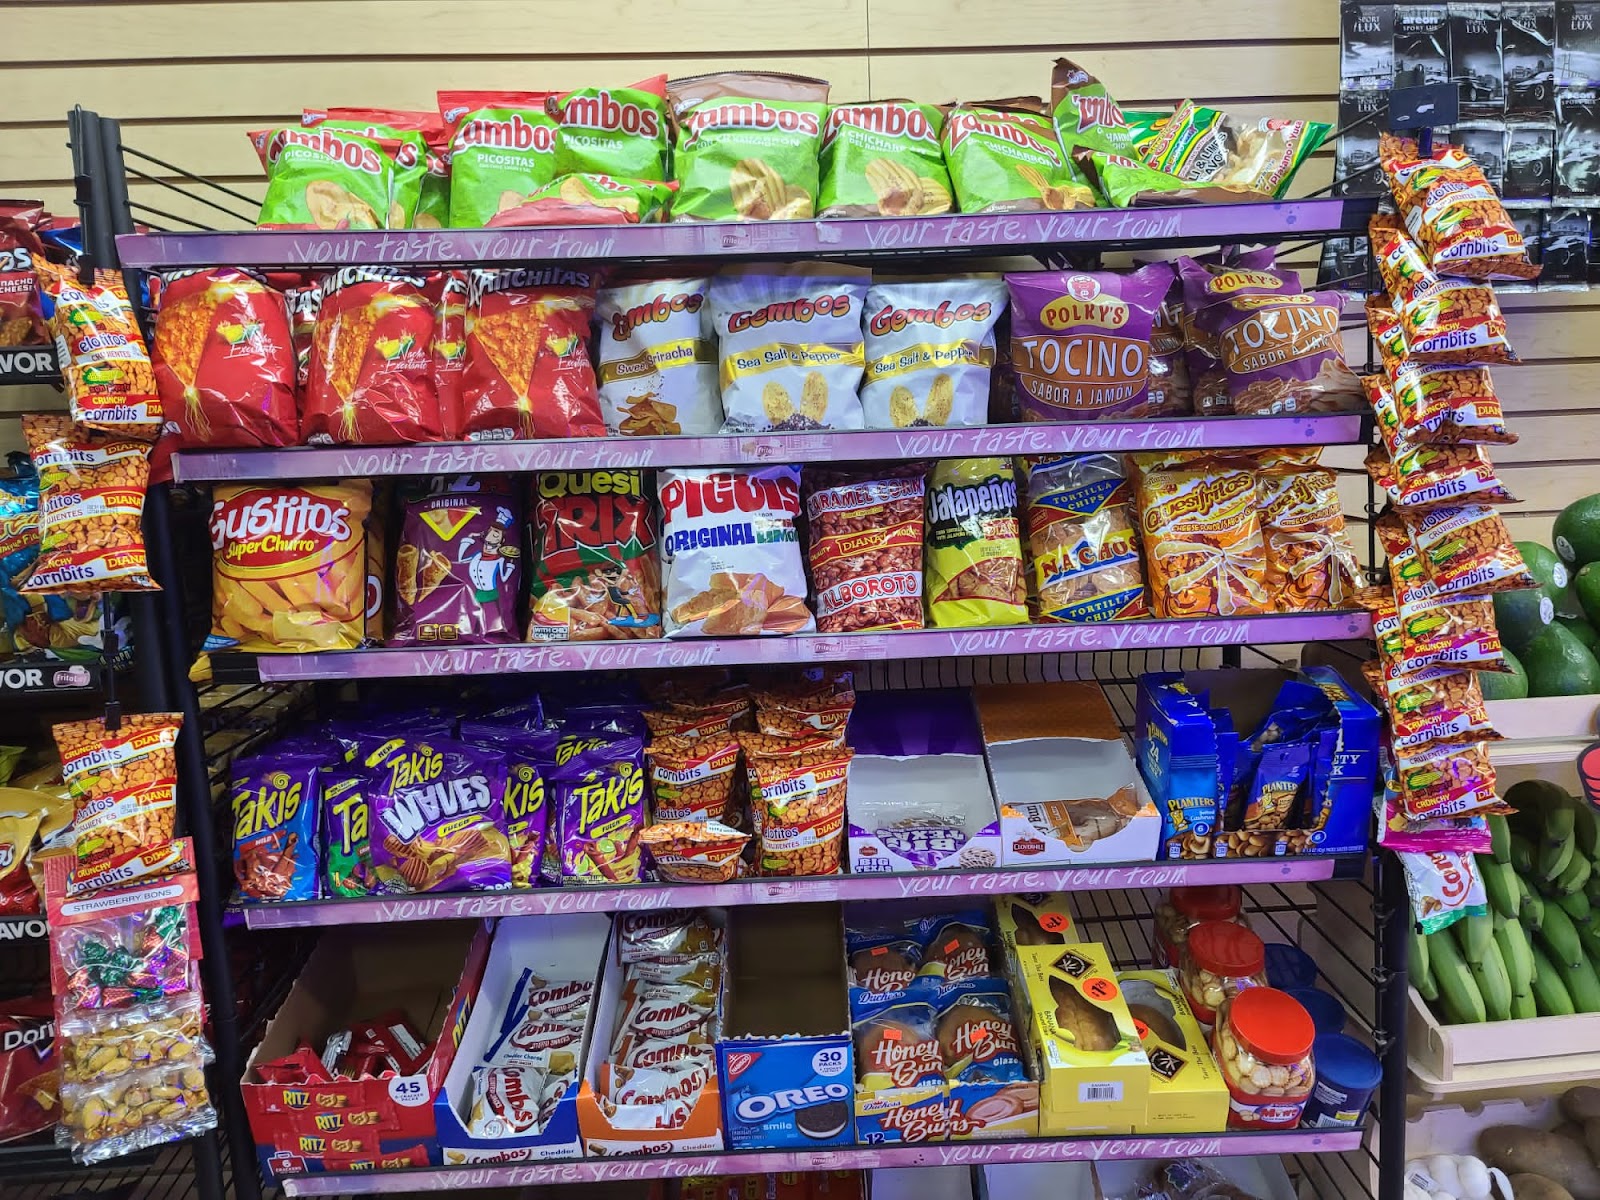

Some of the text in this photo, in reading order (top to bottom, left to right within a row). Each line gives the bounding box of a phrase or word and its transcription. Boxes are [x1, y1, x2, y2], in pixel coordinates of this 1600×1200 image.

[1358, 23, 1381, 32] LUX
[1402, 16, 1438, 25] areon
[1466, 24, 1488, 34] LUX
[1571, 21, 1593, 31] LUX
[563, 135, 624, 151] PICOSITAS
[477, 153, 535, 169] PICOSITAS
[864, 221, 935, 247] your
[1035, 216, 1110, 243] your
[289, 238, 366, 264] your
[470, 237, 545, 260] your
[1440, 240, 1500, 260] cornbits
[1214, 272, 1281, 291] POLKY'S
[728, 293, 851, 334] Gembos
[870, 299, 992, 337] Gembos
[1045, 303, 1125, 326] POLKY'S
[1224, 305, 1340, 356] TOCINO
[1413, 330, 1478, 354] cornbits
[647, 346, 693, 365] Sriracha
[737, 348, 842, 370] Sea Salt & Pepper
[875, 352, 931, 375] Sea Salt &
[1022, 338, 1144, 378] TOCINO
[1243, 348, 1287, 371] SABOR
[92, 396, 127, 405] CRUNCHY
[1031, 380, 1133, 405] SABOR A JAMÓN
[85, 407, 137, 422] cornbits
[895, 434, 962, 458] your
[1062, 427, 1134, 452] your
[337, 450, 413, 476] your
[514, 447, 585, 470] your
[538, 469, 641, 498] Quesi
[877, 478, 924, 499] CORN
[1053, 481, 1113, 505] TORTILLA
[1402, 478, 1467, 506] cornbits
[431, 498, 469, 509] ORIGINAL
[660, 473, 801, 524] PIGUIS
[927, 477, 1018, 525] Jalapeños
[1067, 493, 1106, 512] CHIPS
[209, 495, 351, 550] Gustitos
[1428, 516, 1469, 541] CRUJIENTES
[664, 523, 755, 557] ORIGINAL
[842, 535, 885, 551] DIANA
[27, 565, 94, 588] cornbits
[1437, 565, 1496, 593] cornbits
[1445, 560, 1478, 579] CRUNCHY
[822, 573, 918, 614] ALBOROTO
[1070, 592, 1131, 618] TORTILLA
[950, 633, 1015, 656] your
[1111, 625, 1181, 650] your
[1414, 639, 1452, 653] CRUNCHY
[416, 649, 484, 676] your
[582, 645, 649, 669] your
[1407, 648, 1468, 670] cornbits
[700, 722, 728, 736] DIANA
[1402, 721, 1460, 746] cornbits
[1407, 713, 1442, 731] CRUNCHY
[64, 742, 101, 759] CRUNCHY
[1409, 747, 1449, 766] CRUJIENTES
[63, 748, 122, 778] cornbits
[386, 748, 444, 796] Takis
[817, 767, 845, 781] DIANA
[658, 767, 702, 783] cornbits
[139, 788, 173, 805] DIANA
[573, 767, 644, 835] Takis
[1167, 797, 1216, 812] PLANTERS
[1415, 792, 1450, 809] CRUNCHY
[232, 781, 302, 840] Takis
[381, 775, 491, 842] WAVES
[764, 827, 799, 841] elotitos
[1197, 824, 1205, 833] 6
[1314, 832, 1322, 842] 6
[77, 861, 112, 878] CRUNCHY
[858, 857, 890, 867] BIG
[71, 865, 134, 895] cornbits
[898, 875, 963, 898] your
[1054, 868, 1121, 890] your
[73, 888, 172, 913] STRAWBERRY BONS
[376, 897, 446, 922] your
[542, 892, 608, 914] your
[1044, 1010, 1057, 1036] BANANA
[818, 1051, 842, 1062] 30
[871, 1039, 943, 1065] Honey
[972, 1033, 1018, 1062] Bun
[890, 1060, 942, 1087] Bun
[283, 1090, 311, 1107] RITZ
[396, 1081, 421, 1094] 45
[503, 1066, 533, 1123] Combos
[738, 1083, 849, 1119] OREO
[863, 1100, 901, 1112] Duchess
[316, 1114, 344, 1132] RITZ
[762, 1122, 793, 1131] smile
[299, 1136, 327, 1154] RITZ
[865, 1132, 885, 1145] 12
[540, 1148, 575, 1157] Cheddar
[939, 1146, 1002, 1166] your
[1089, 1138, 1157, 1160] your
[430, 1165, 499, 1189] your
[588, 1162, 654, 1182] your
